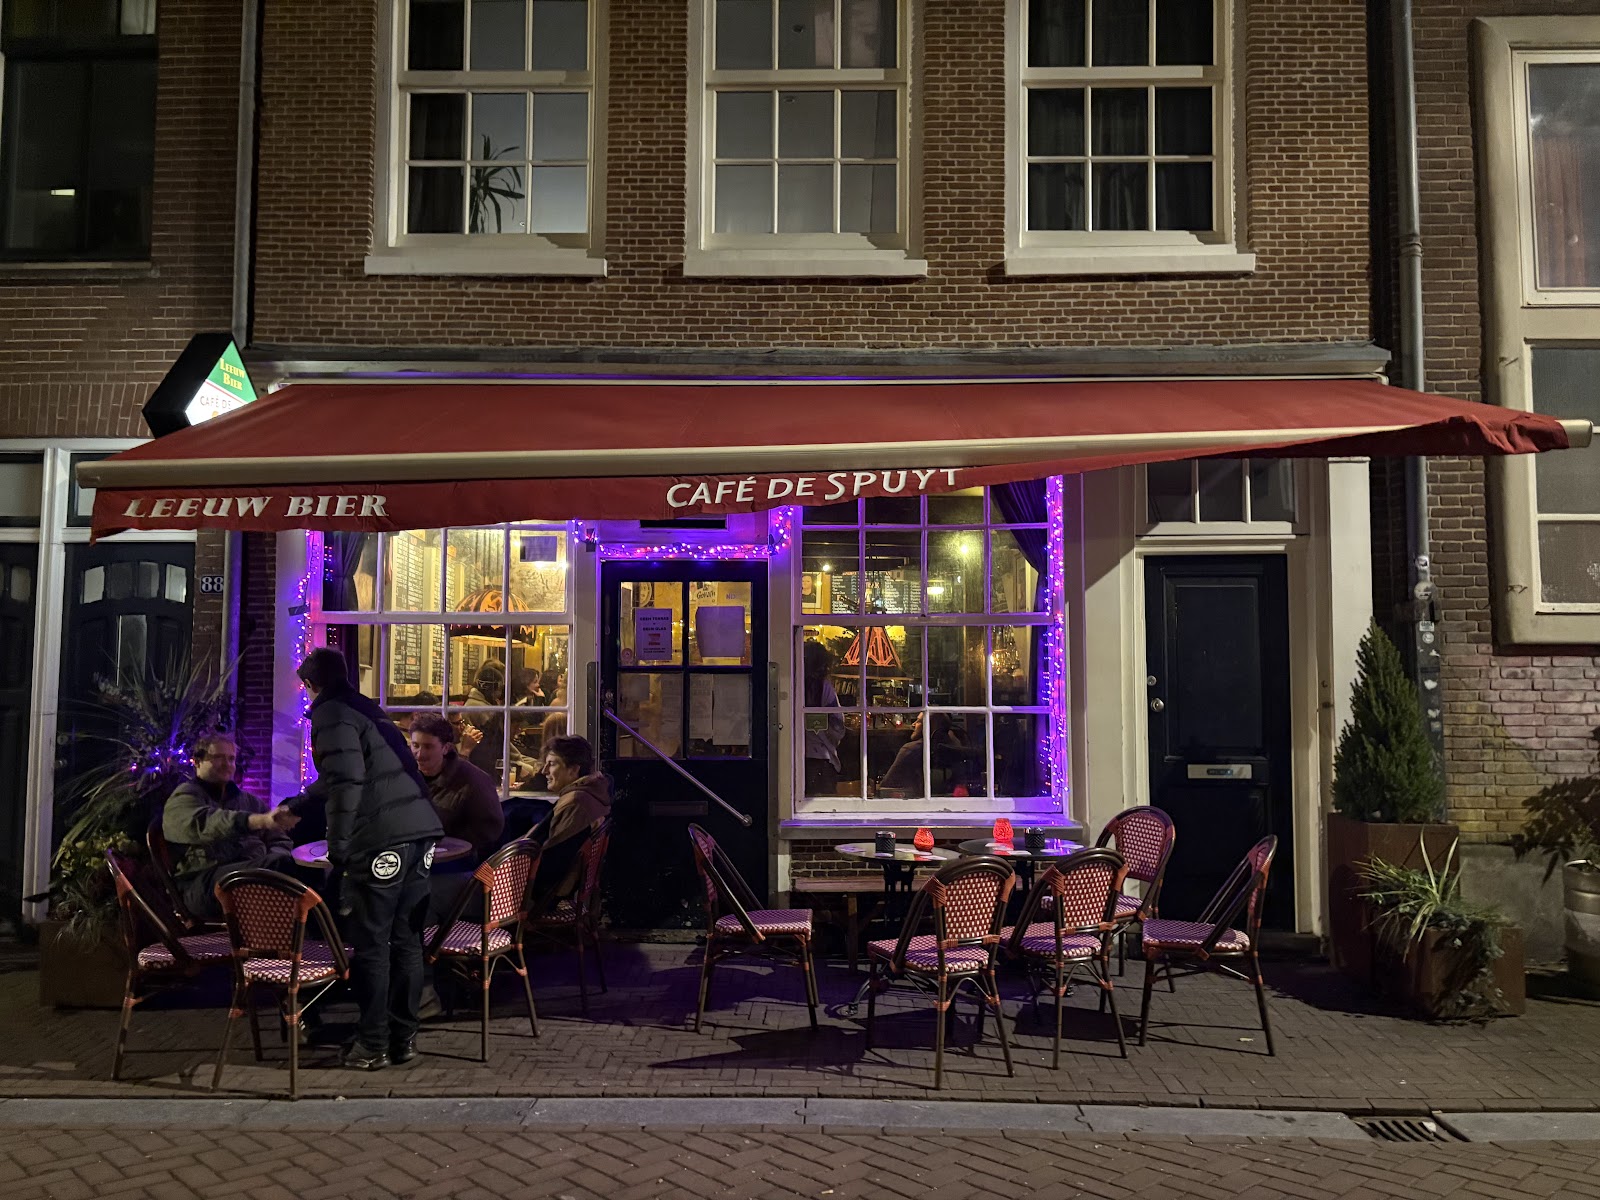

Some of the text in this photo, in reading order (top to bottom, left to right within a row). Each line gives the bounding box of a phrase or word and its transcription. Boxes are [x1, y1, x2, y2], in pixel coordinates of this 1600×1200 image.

[219, 357, 246, 378] LEEUW
[223, 372, 243, 390] BIER
[666, 468, 963, 508] CAFÉ DE SPUYT
[121, 494, 389, 518] LEEUW BIER
[201, 576, 224, 593] 88
